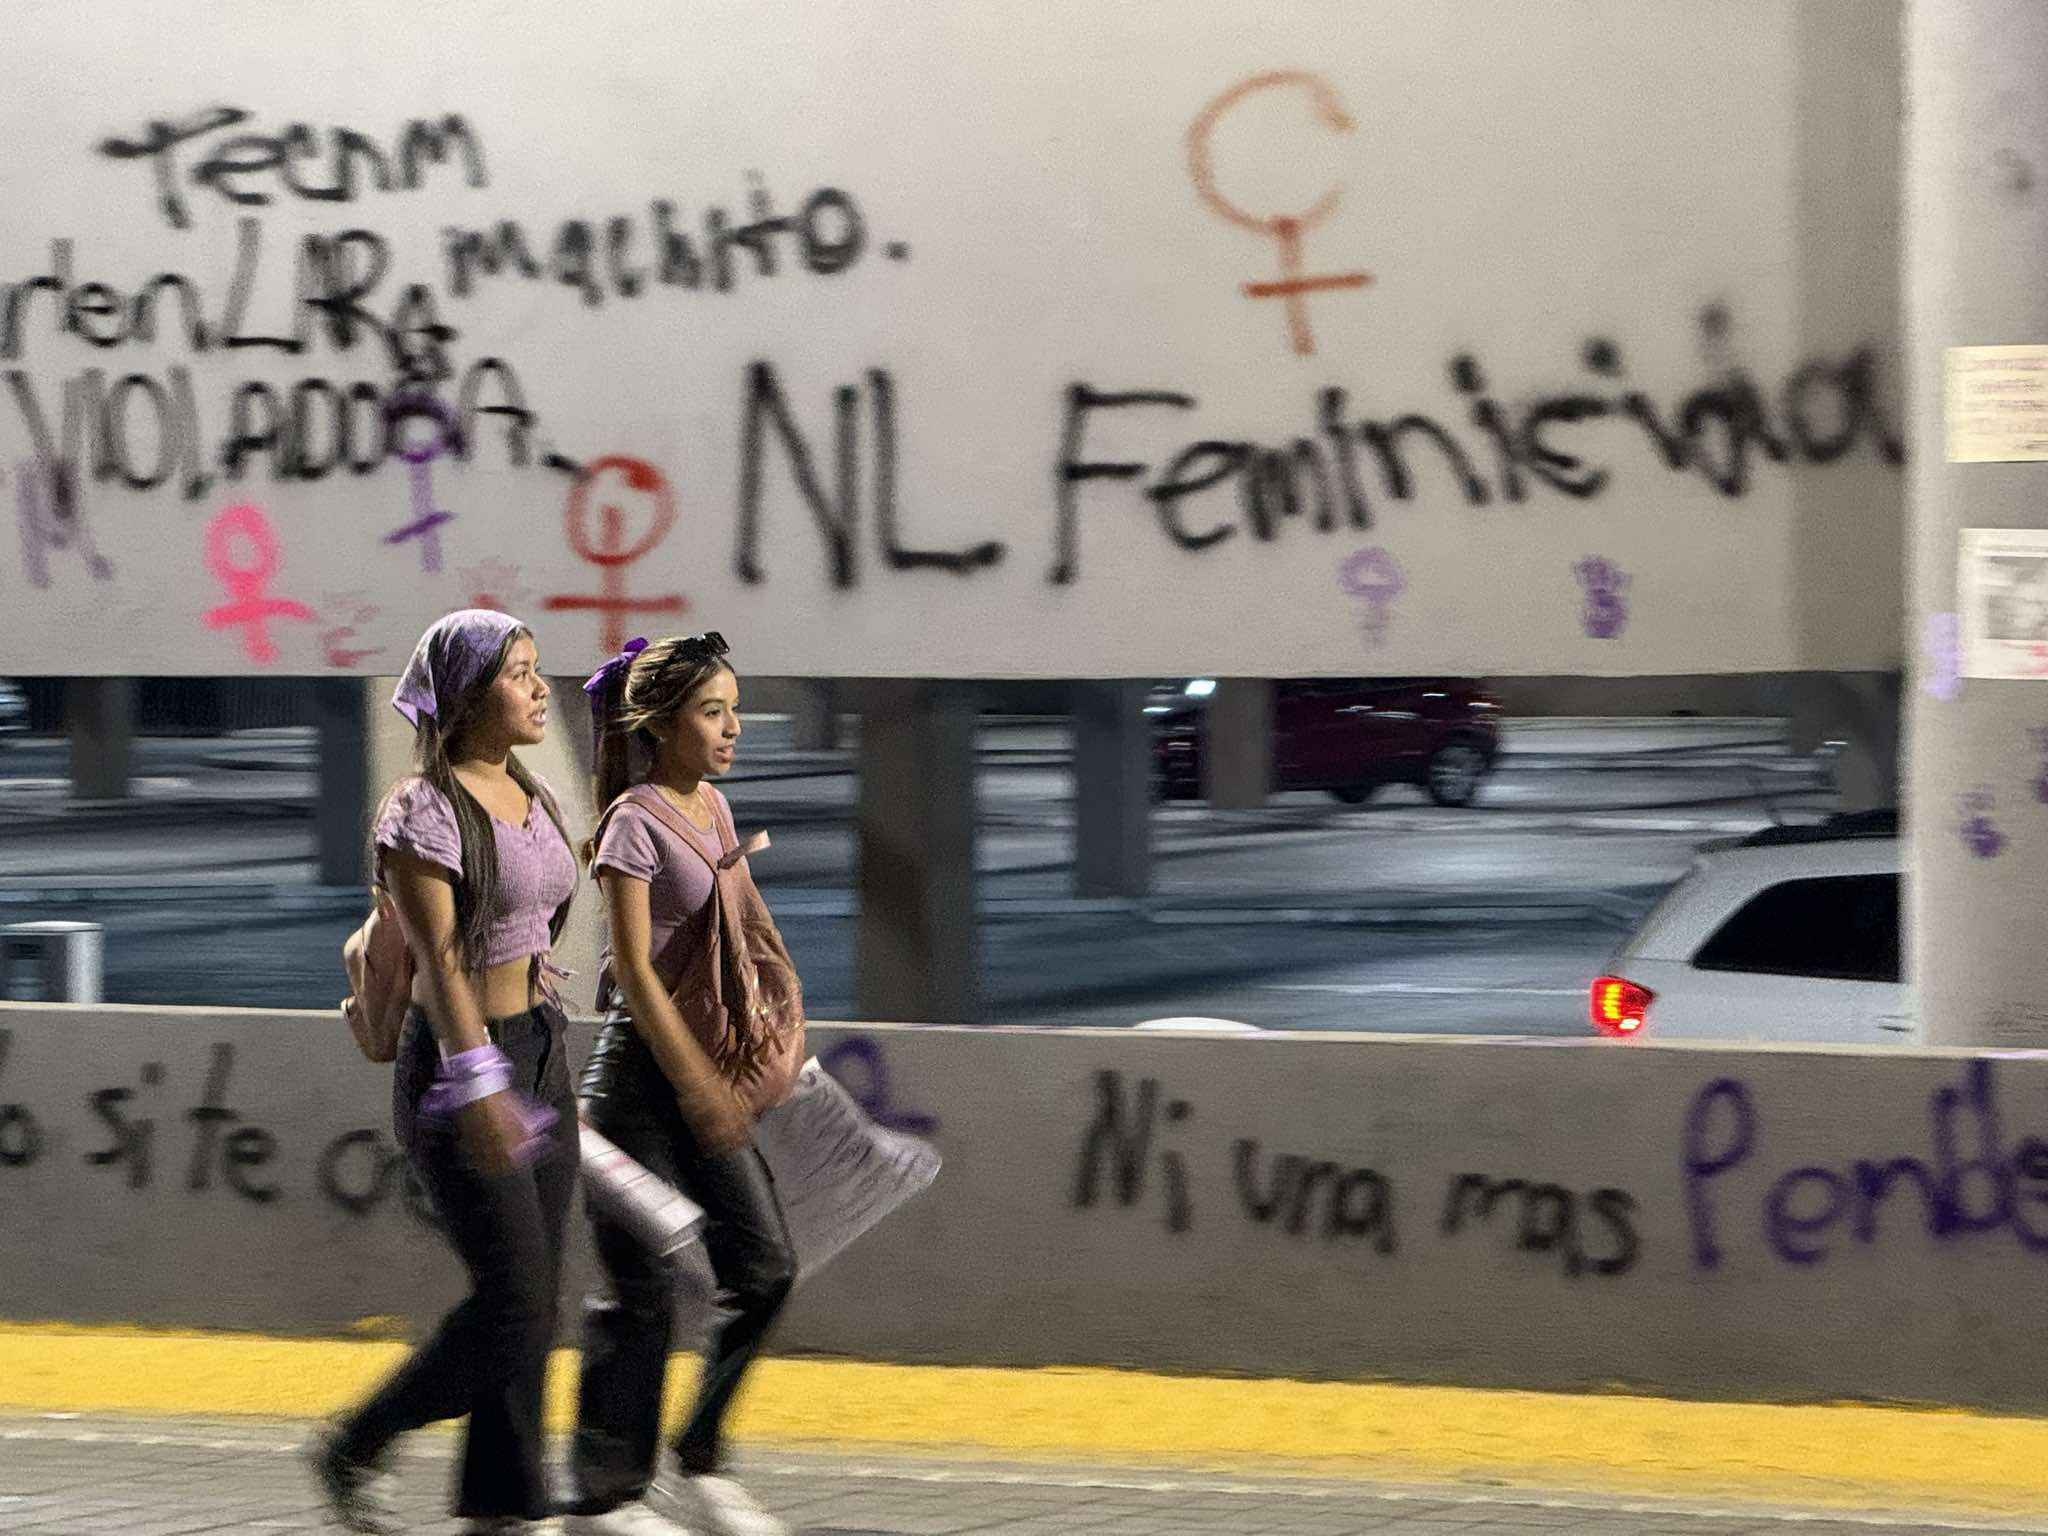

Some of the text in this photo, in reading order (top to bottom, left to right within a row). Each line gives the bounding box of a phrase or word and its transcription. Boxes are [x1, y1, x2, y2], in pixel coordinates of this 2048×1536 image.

[732, 358, 1007, 592] NL
[1074, 1068, 1193, 1236] Ni
[1232, 1137, 1396, 1258] una
[1438, 1172, 1640, 1278] mas
